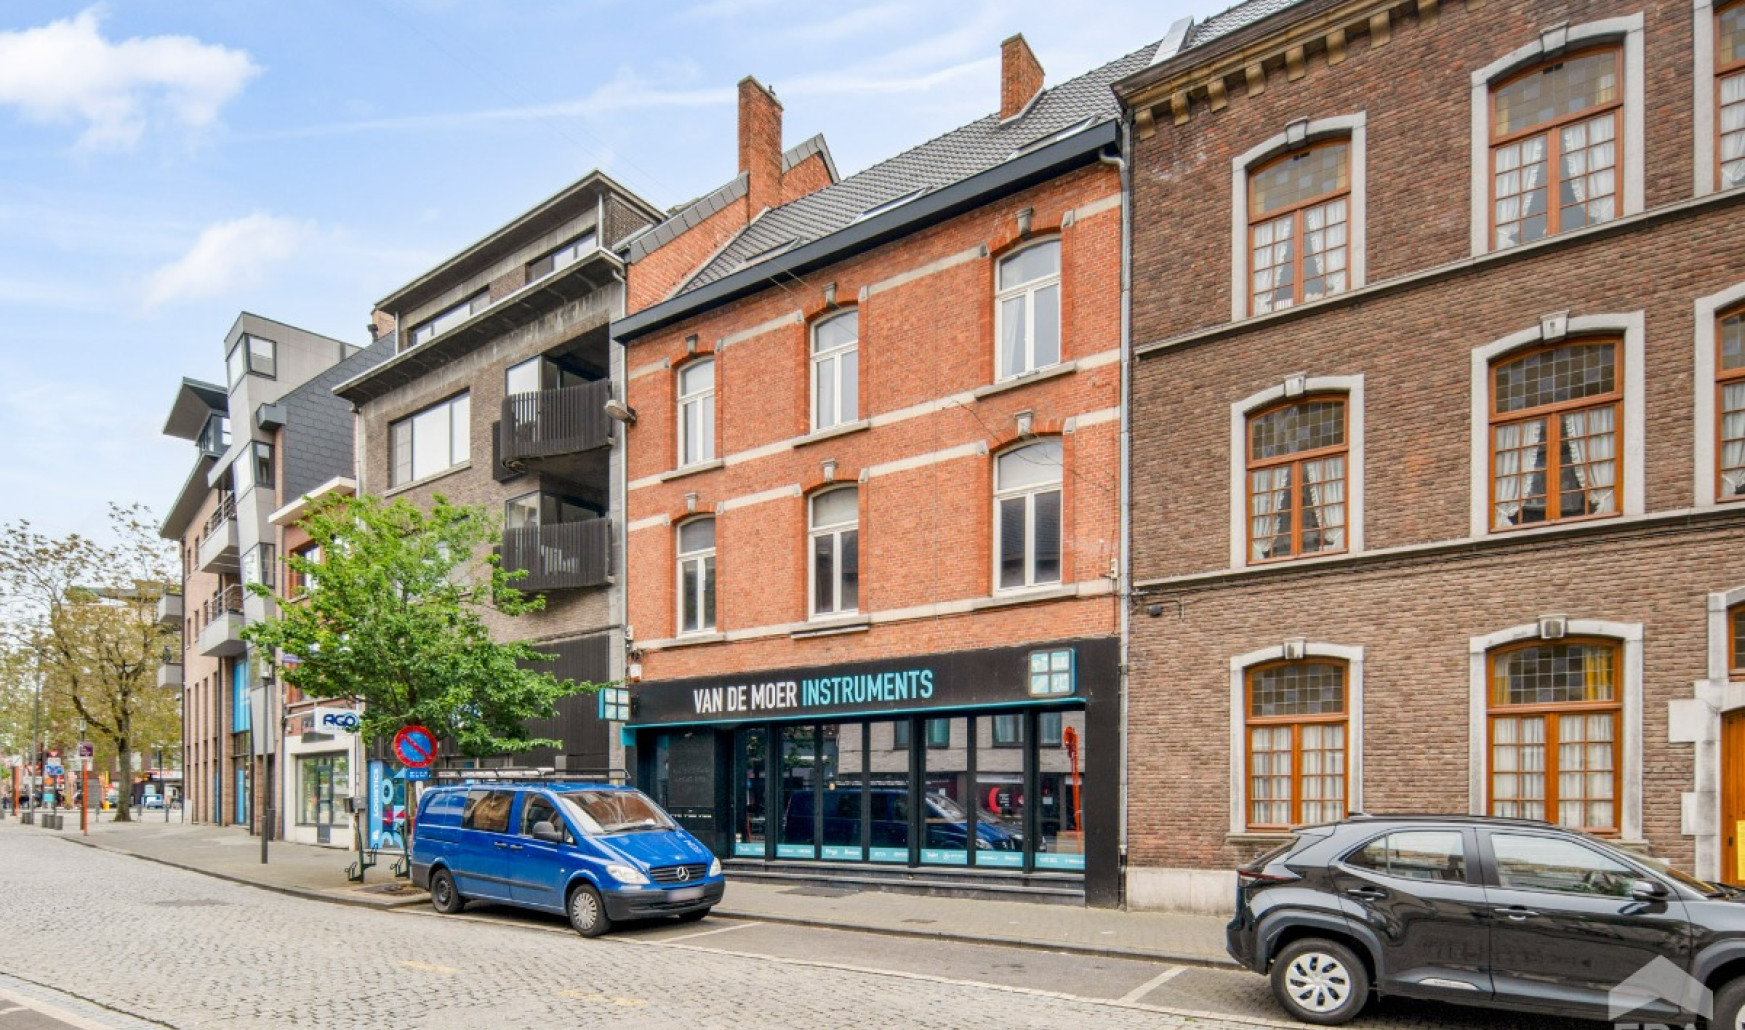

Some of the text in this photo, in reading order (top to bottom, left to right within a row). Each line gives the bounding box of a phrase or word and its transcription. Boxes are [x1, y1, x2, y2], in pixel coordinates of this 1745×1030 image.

[693, 669, 933, 714] VAN DE MOER INSTRUMENTS
[323, 713, 357, 727] AGO
